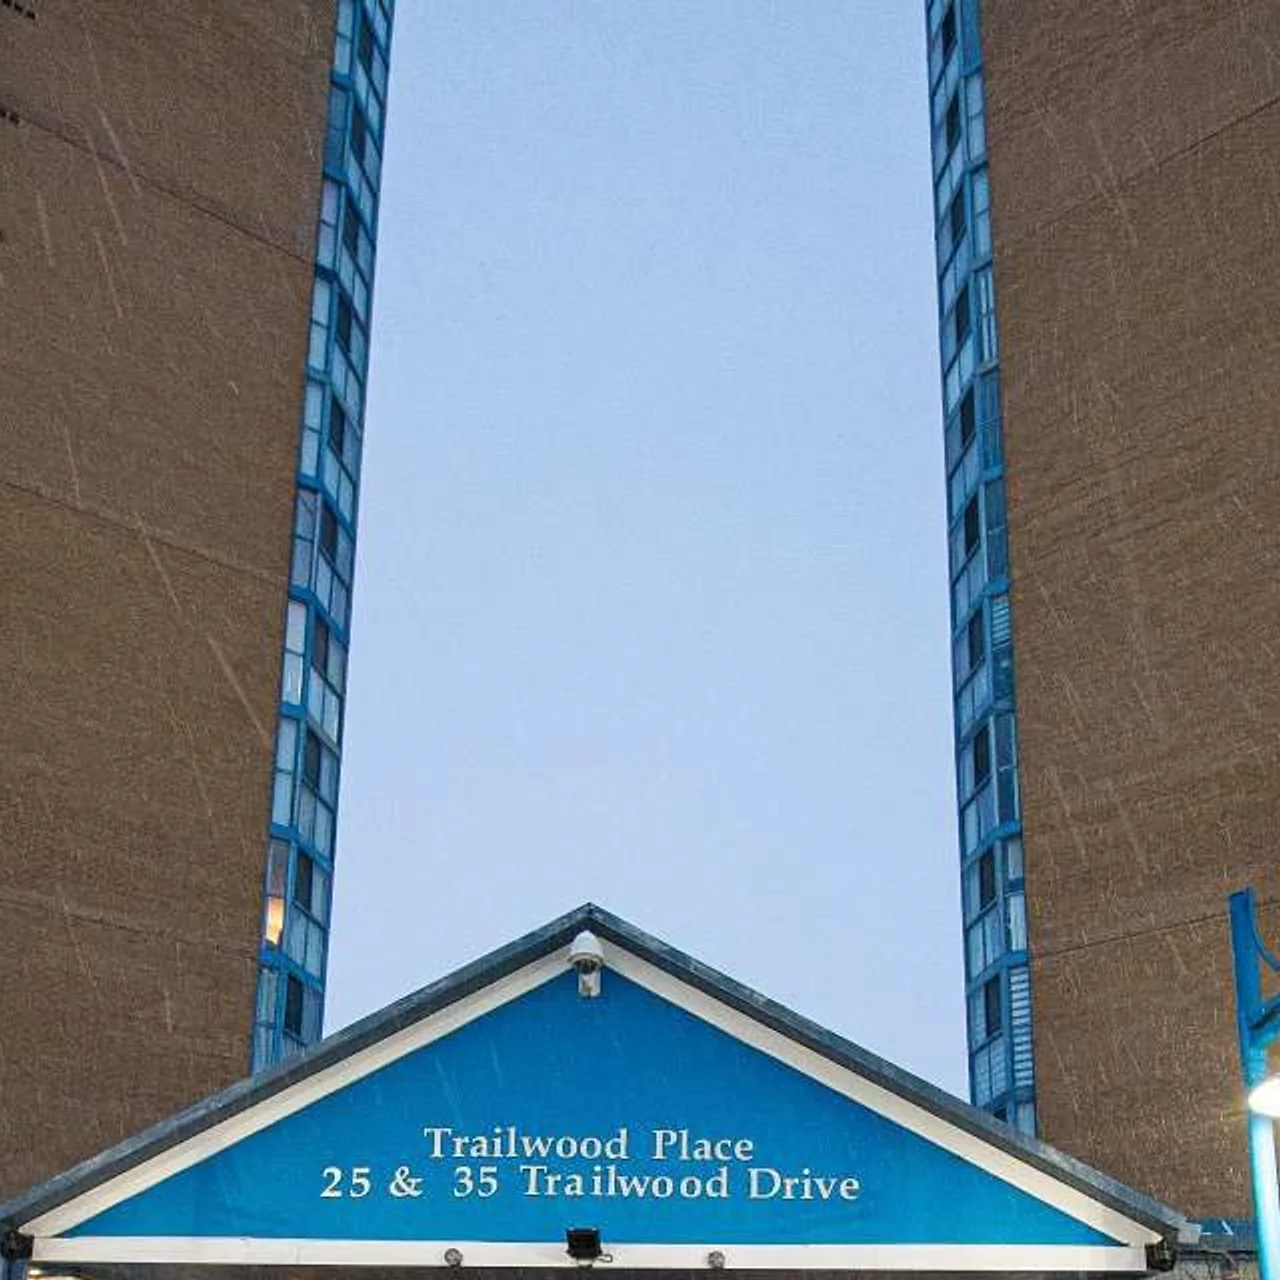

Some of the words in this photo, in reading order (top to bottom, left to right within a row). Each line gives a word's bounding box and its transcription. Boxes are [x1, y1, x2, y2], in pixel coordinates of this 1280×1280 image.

[424, 1126, 629, 1160] Trailwood
[651, 1128, 754, 1161] Place
[320, 1165, 371, 1198] 25
[388, 1165, 424, 1197] &
[453, 1165, 498, 1198] 35
[520, 1164, 730, 1199] Trailwood
[747, 1167, 861, 1200] Drive
